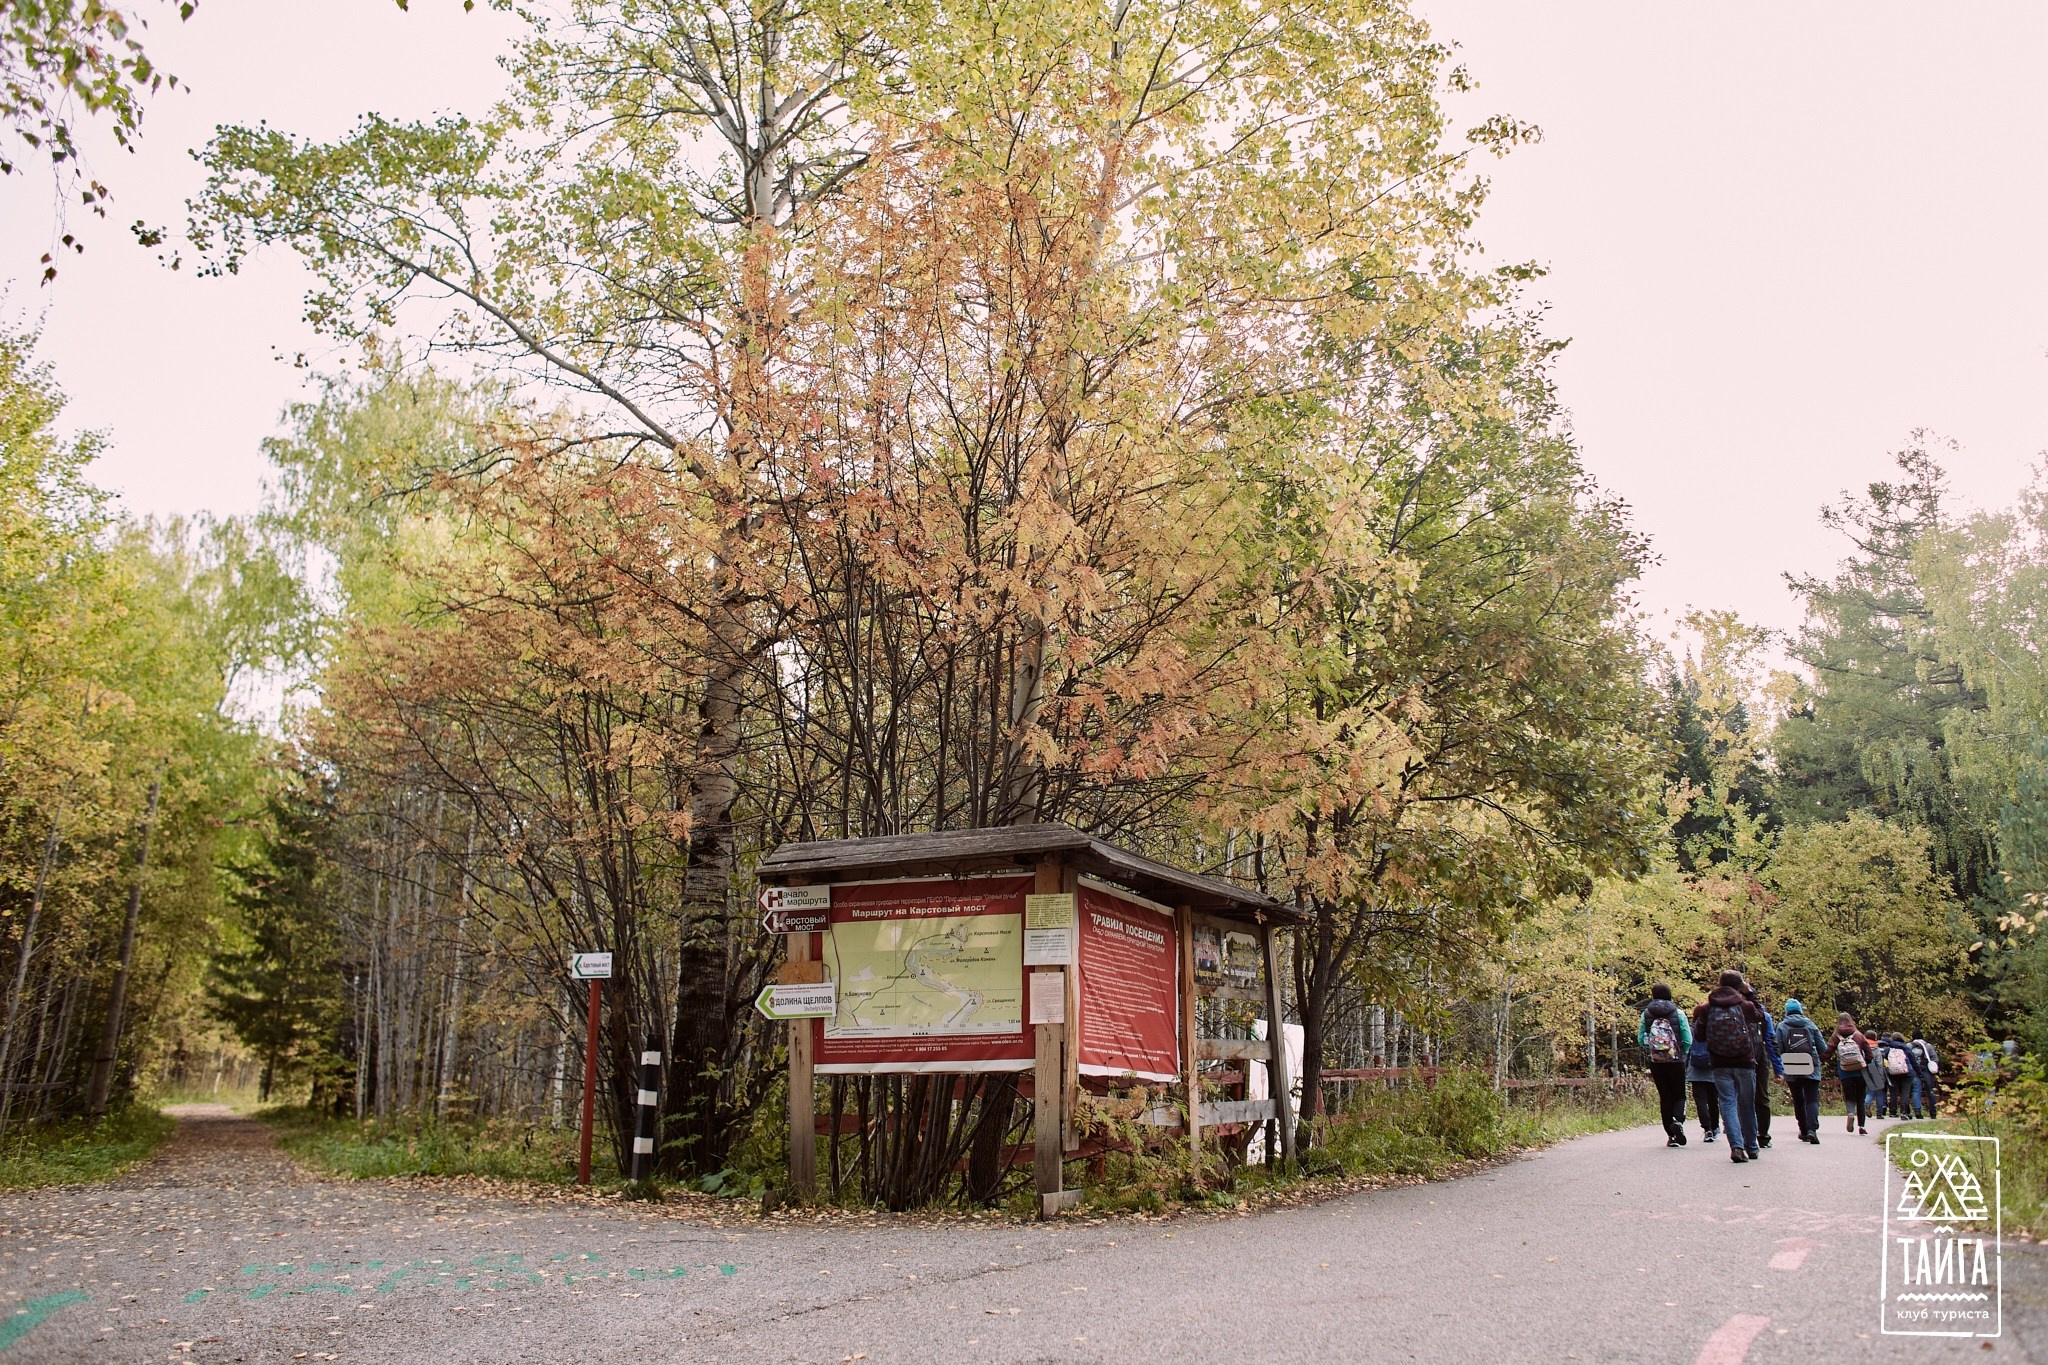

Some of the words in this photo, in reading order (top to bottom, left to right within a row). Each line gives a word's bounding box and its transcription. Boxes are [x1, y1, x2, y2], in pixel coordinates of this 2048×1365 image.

[768, 890, 809, 908] Начало
[787, 897, 828, 906] маршрута
[852, 908, 893, 918] Маршрут
[910, 904, 961, 915] Карстовый
[964, 904, 987, 912] мост
[773, 911, 827, 931] Карстовый
[775, 996, 803, 1007] ДОЛИНА
